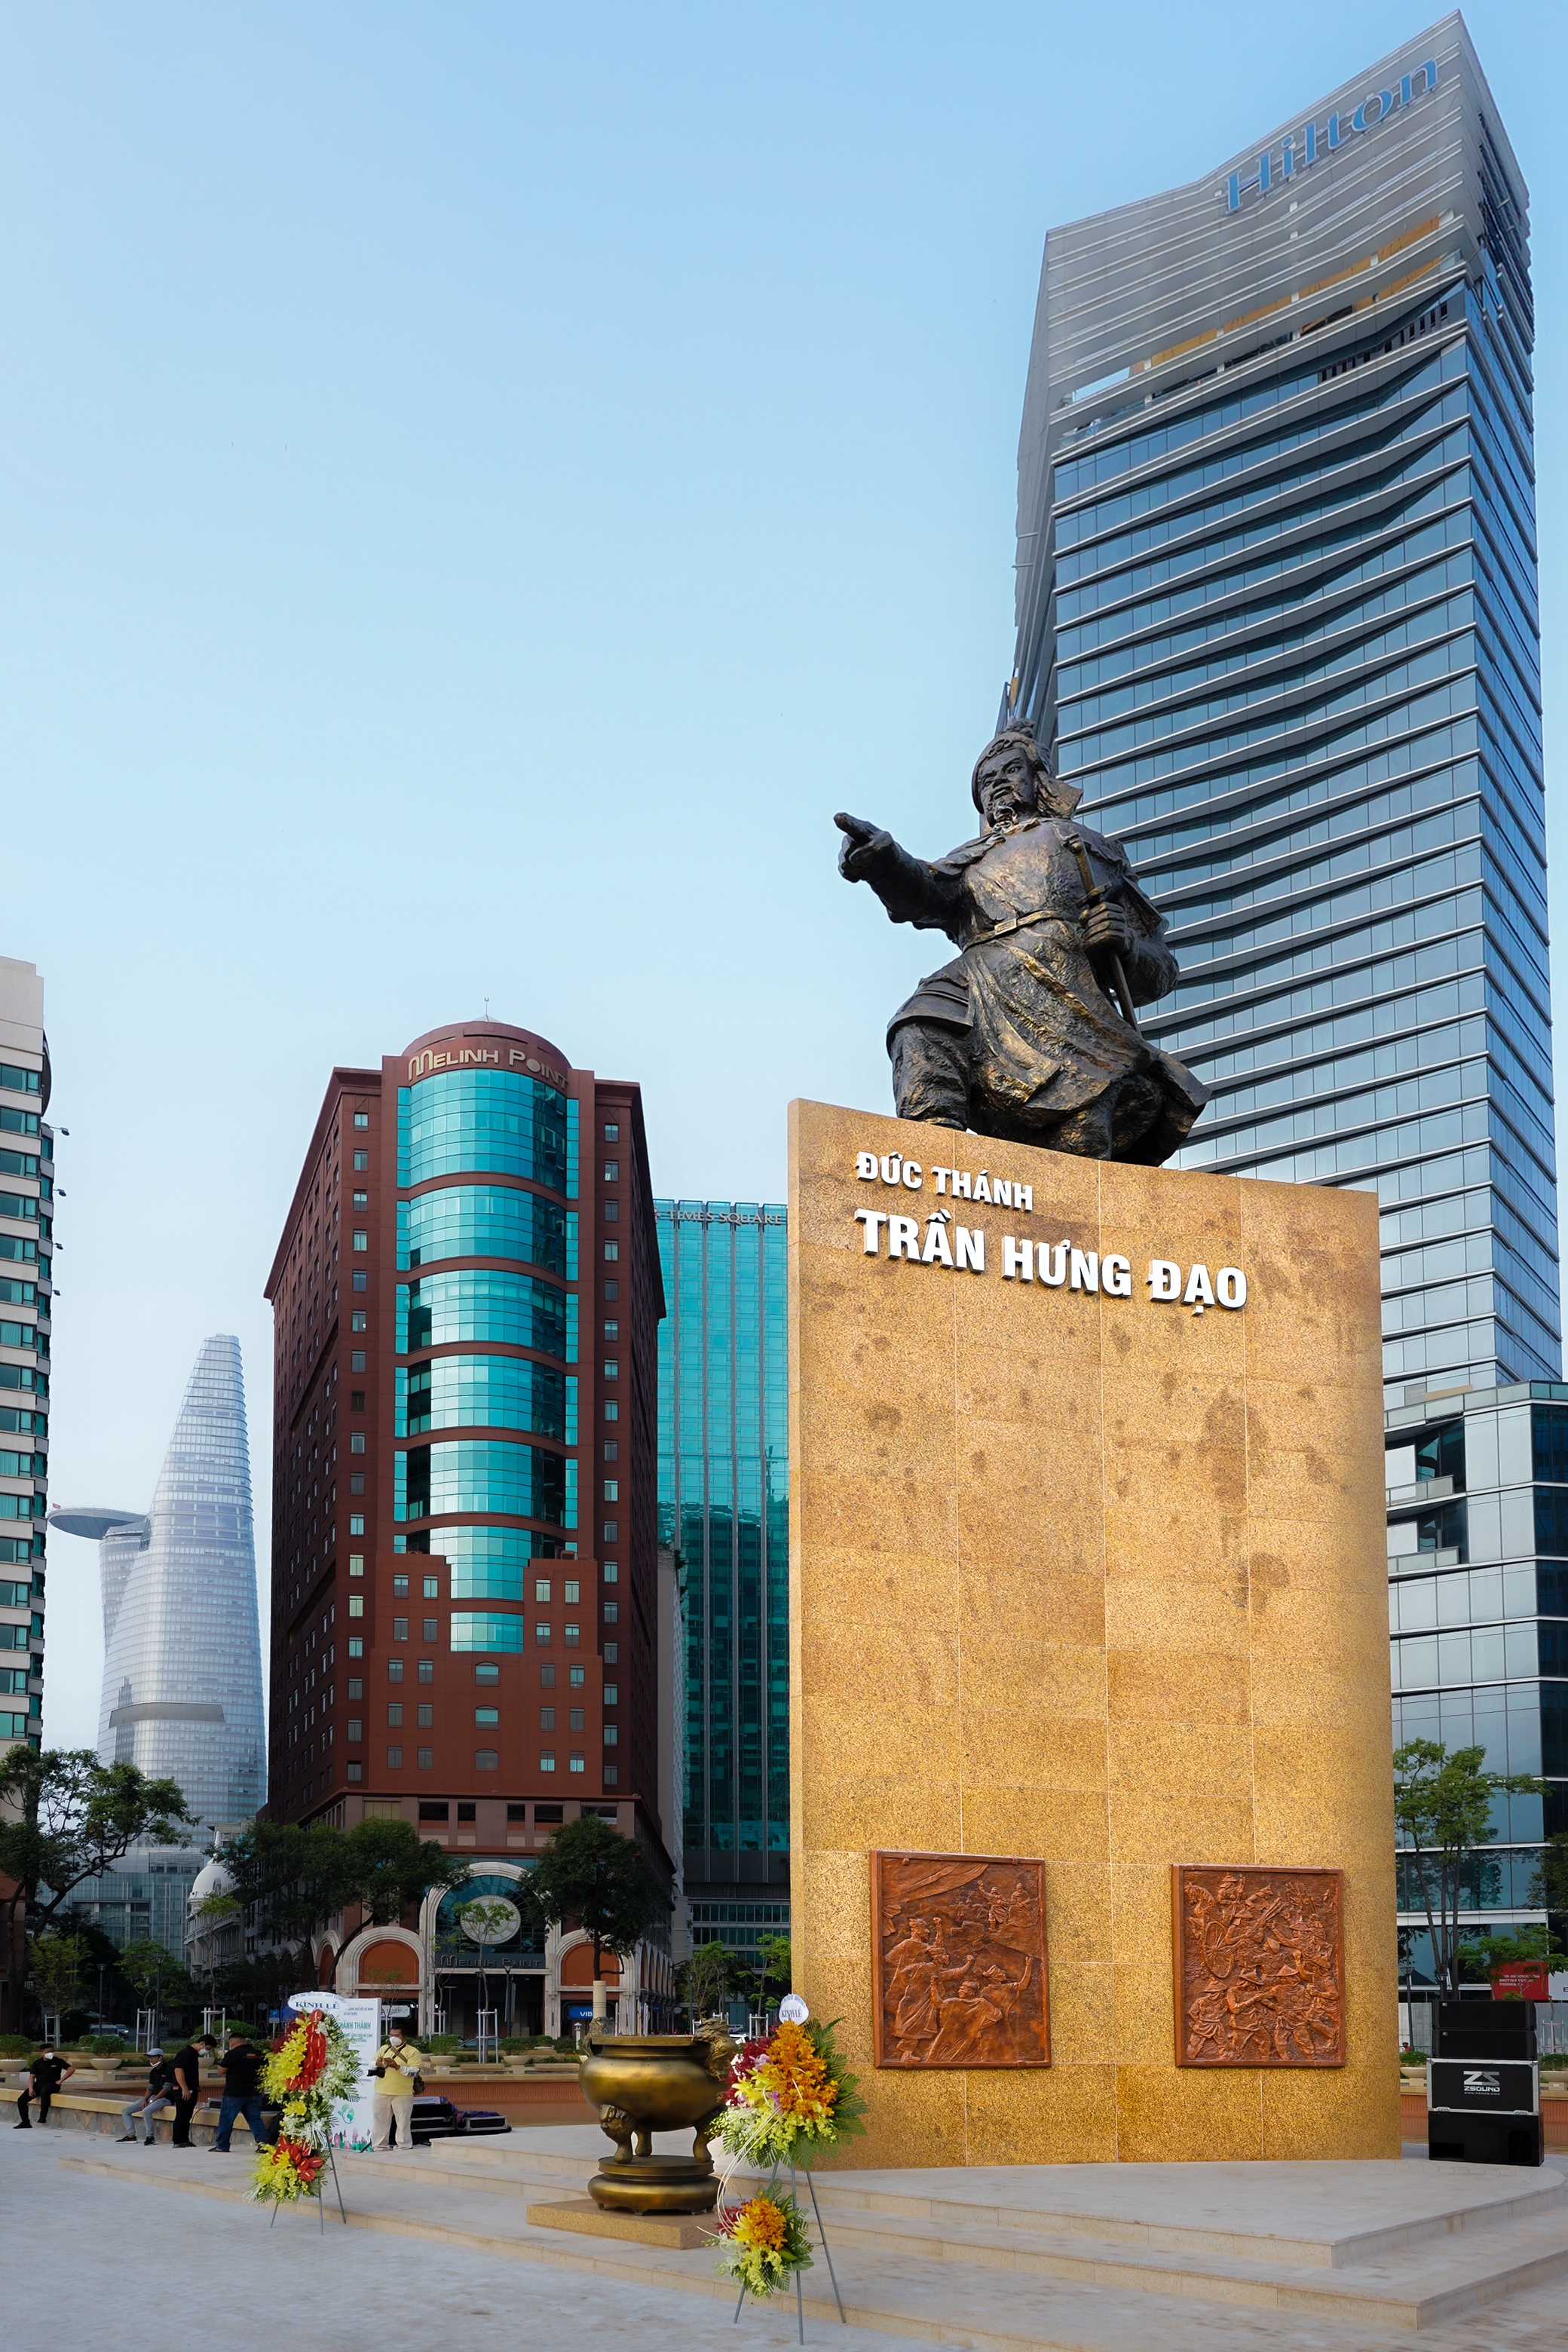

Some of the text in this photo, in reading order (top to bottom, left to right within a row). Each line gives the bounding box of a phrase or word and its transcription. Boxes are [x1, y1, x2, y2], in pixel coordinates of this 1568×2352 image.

[1226, 57, 1440, 213] Hilton
[669, 1208, 782, 1226] TIMES SQUARE
[855, 1150, 1034, 1212] ĐỨC THÁNH
[854, 1207, 1248, 1316] TRẦN HƯNG ĐẠO
